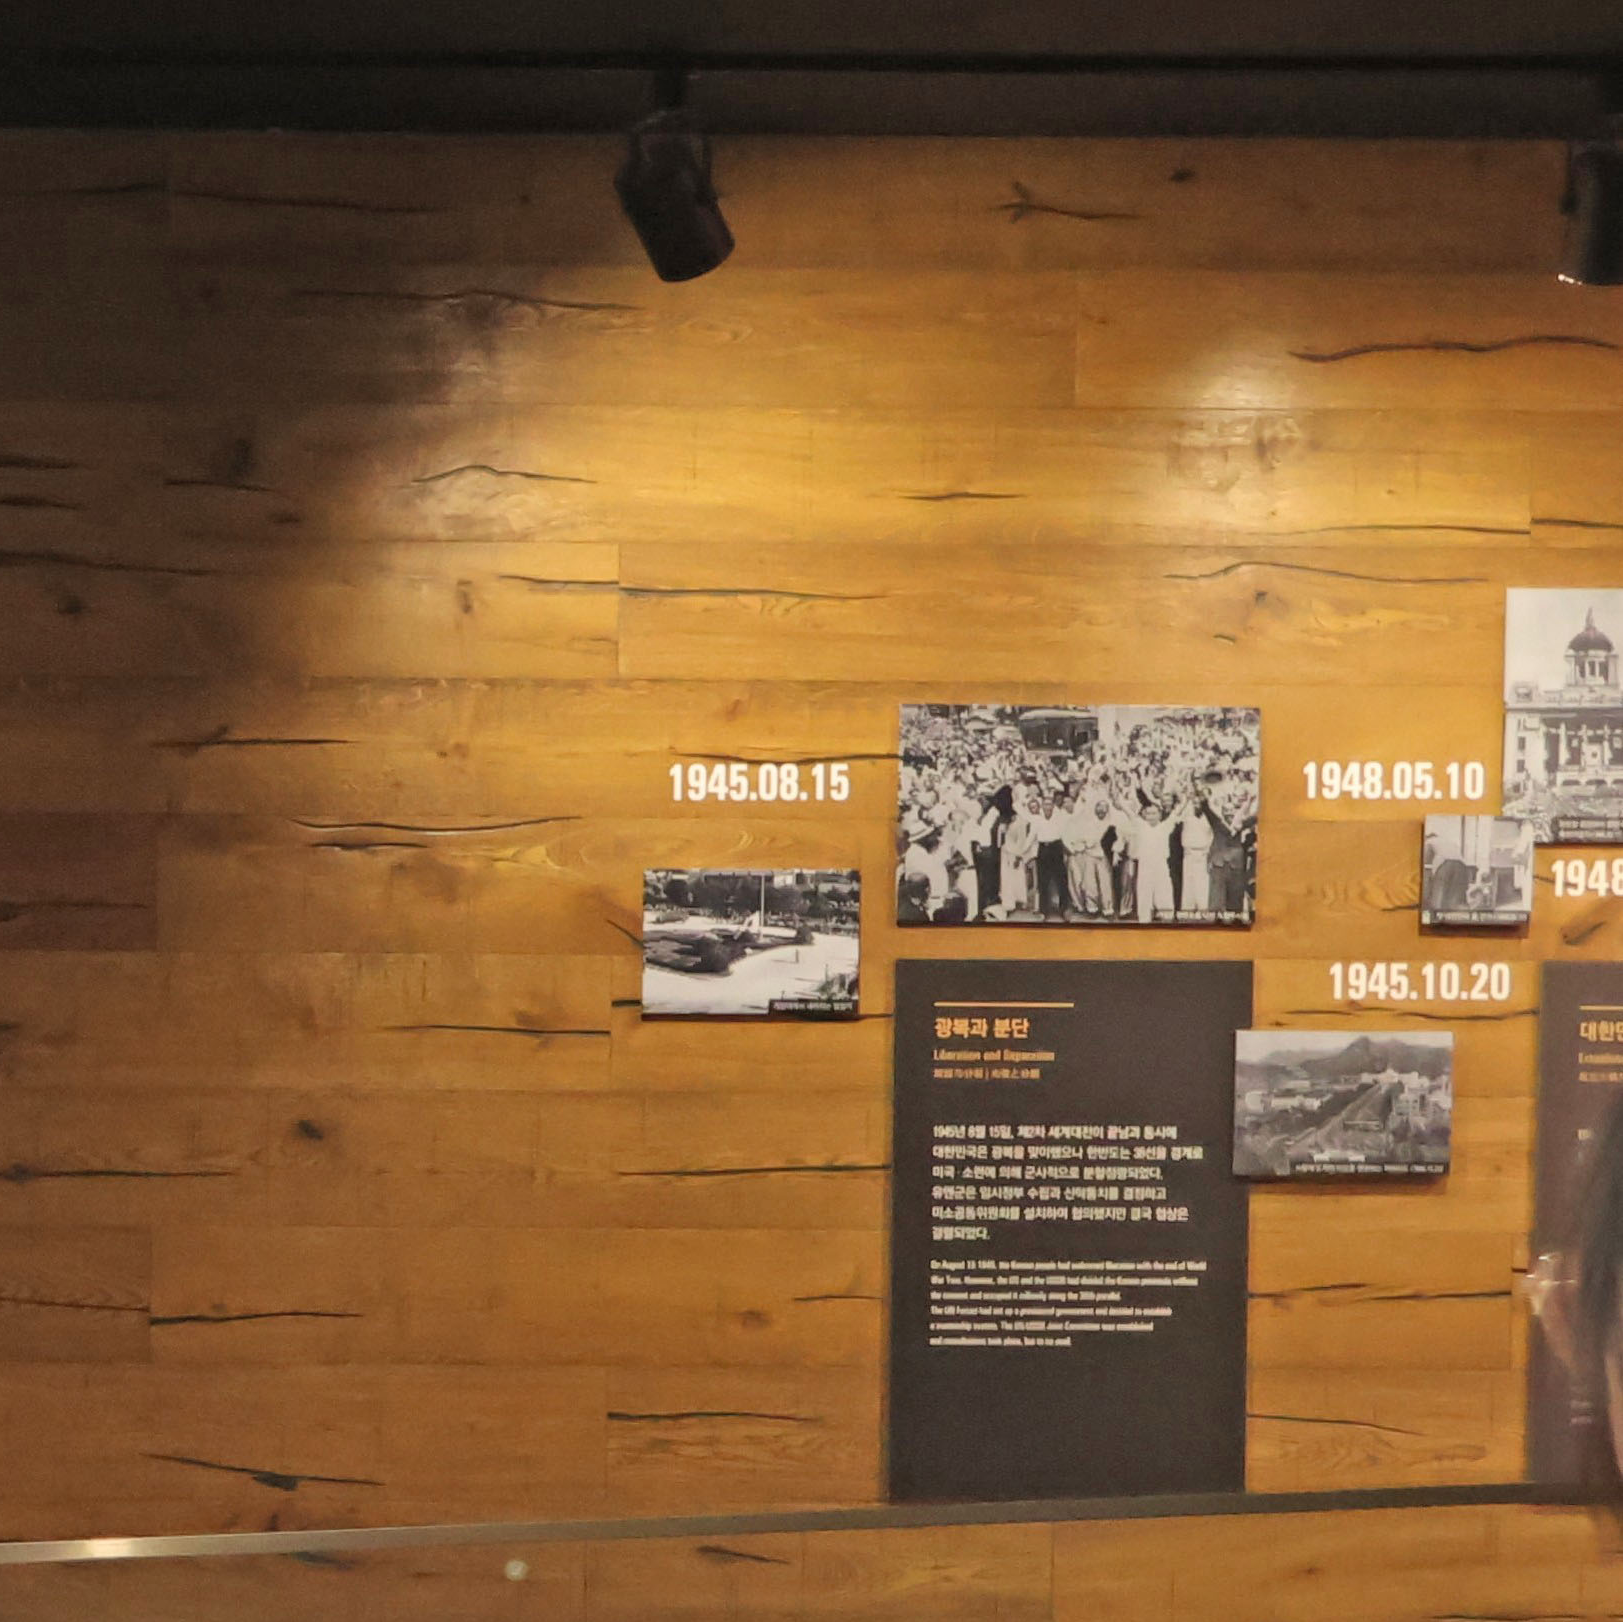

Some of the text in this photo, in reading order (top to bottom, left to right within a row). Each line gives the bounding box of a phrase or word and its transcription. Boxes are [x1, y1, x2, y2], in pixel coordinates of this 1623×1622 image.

[669, 762, 850, 802] 1945.08.15
[1302, 760, 1484, 800] 1948.05.10
[1329, 961, 1510, 1001] 1945.10.20
[934, 1017, 1030, 1039] 광복과 분단
